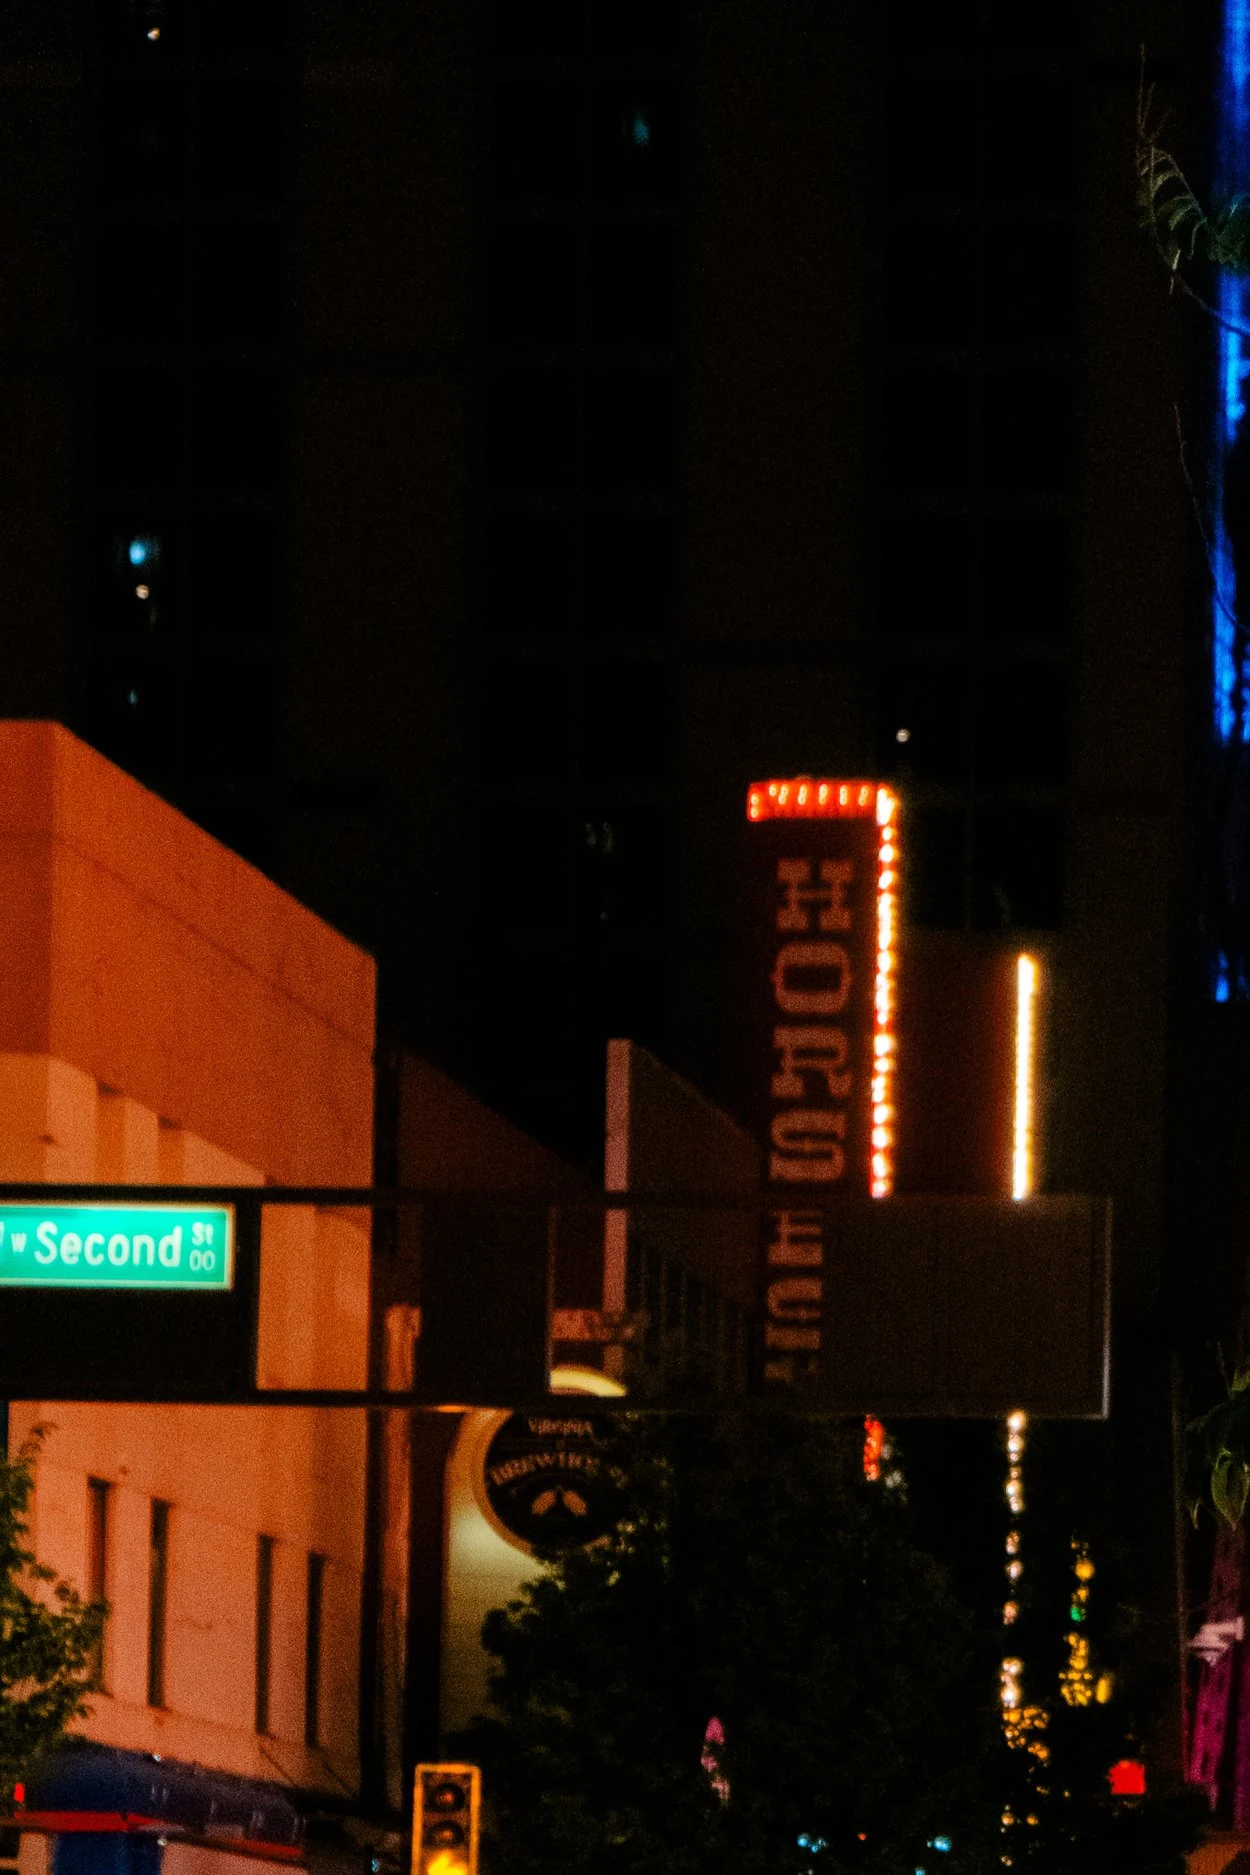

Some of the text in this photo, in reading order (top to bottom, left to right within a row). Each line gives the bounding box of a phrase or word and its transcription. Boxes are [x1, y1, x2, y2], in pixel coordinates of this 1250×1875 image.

[10, 1220, 214, 1268] W Second St
